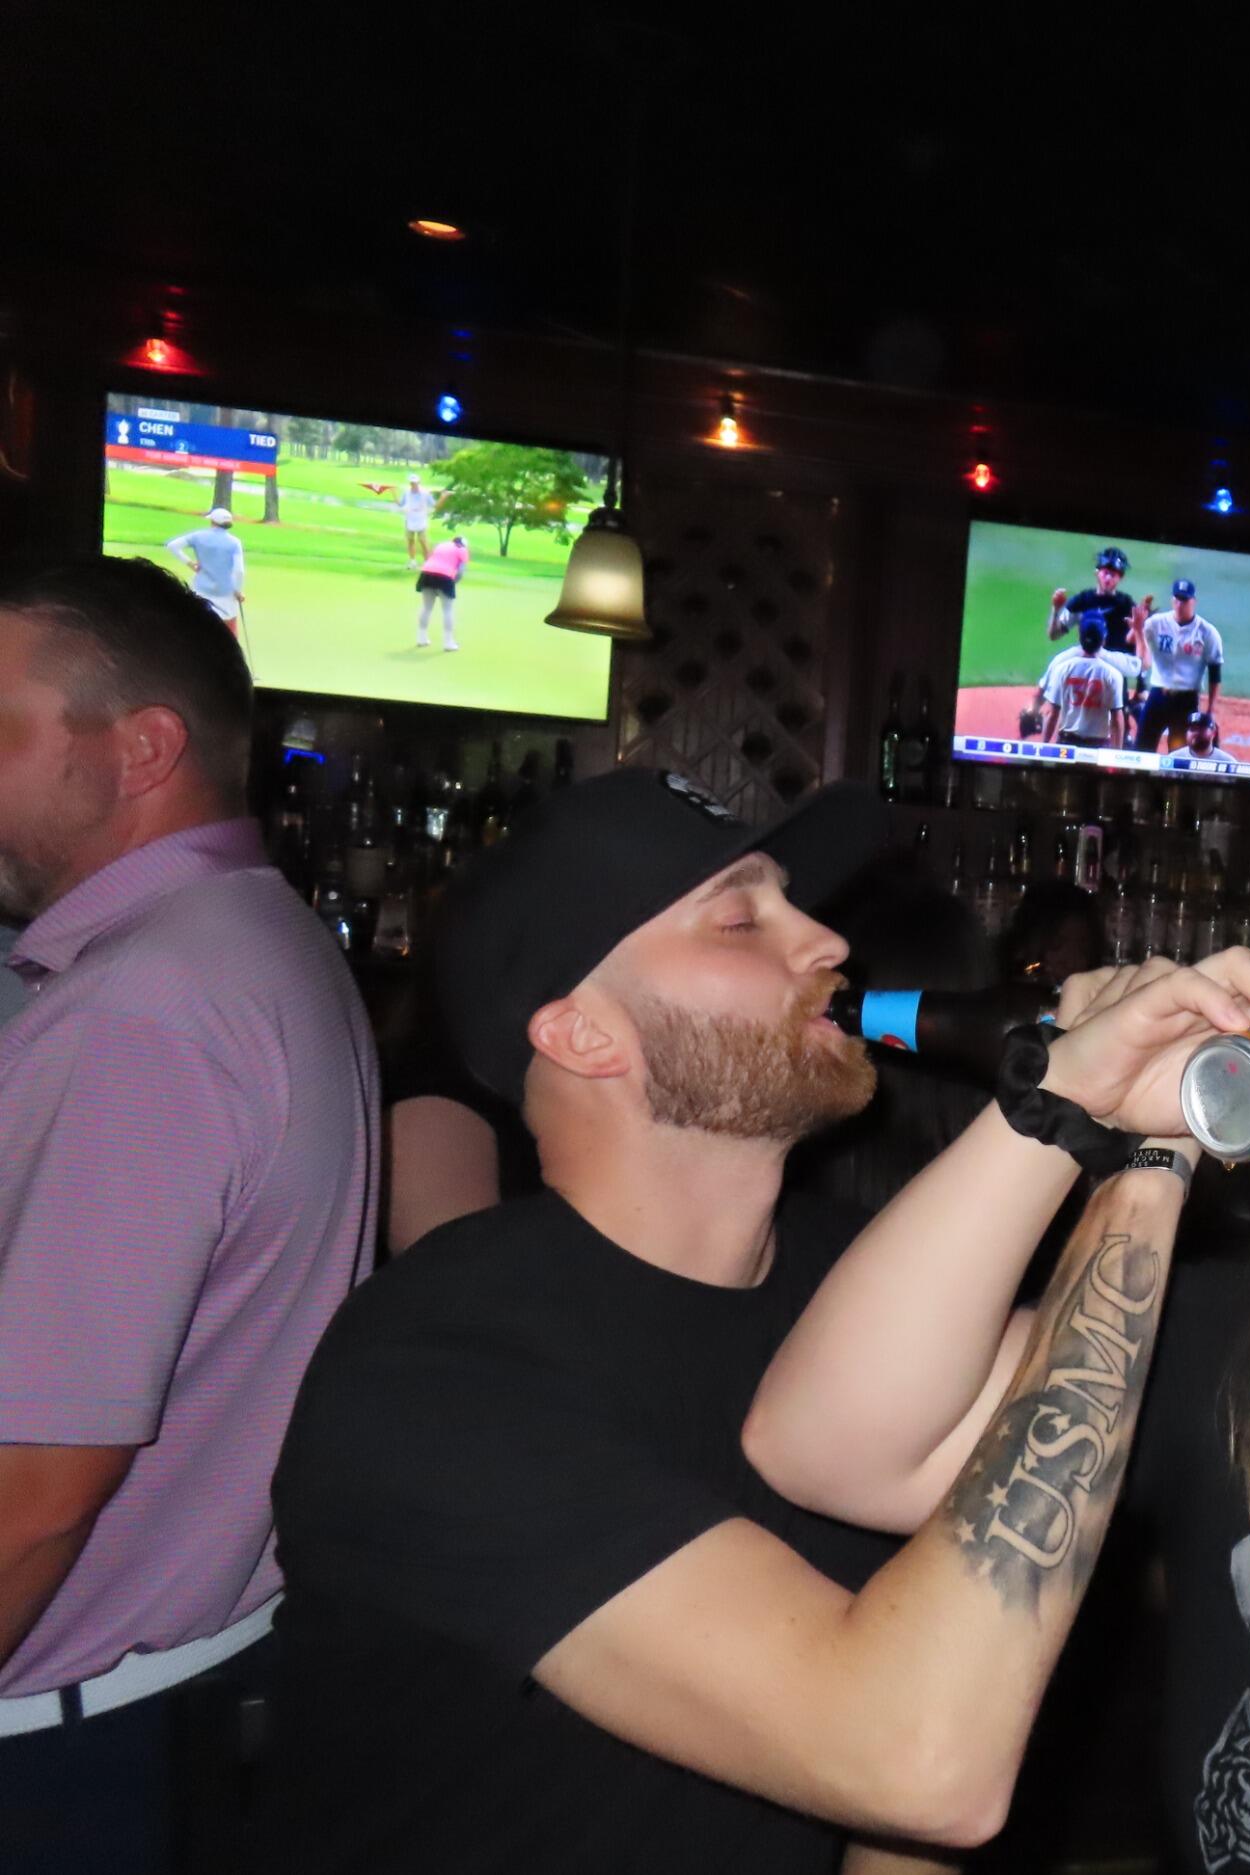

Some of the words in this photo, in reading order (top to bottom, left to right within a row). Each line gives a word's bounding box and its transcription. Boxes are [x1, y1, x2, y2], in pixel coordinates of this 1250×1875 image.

[139, 421, 174, 436] CHEN
[249, 433, 276, 448] TIED
[1060, 748, 1068, 758] 2
[984, 1233, 1159, 1569] USMC
